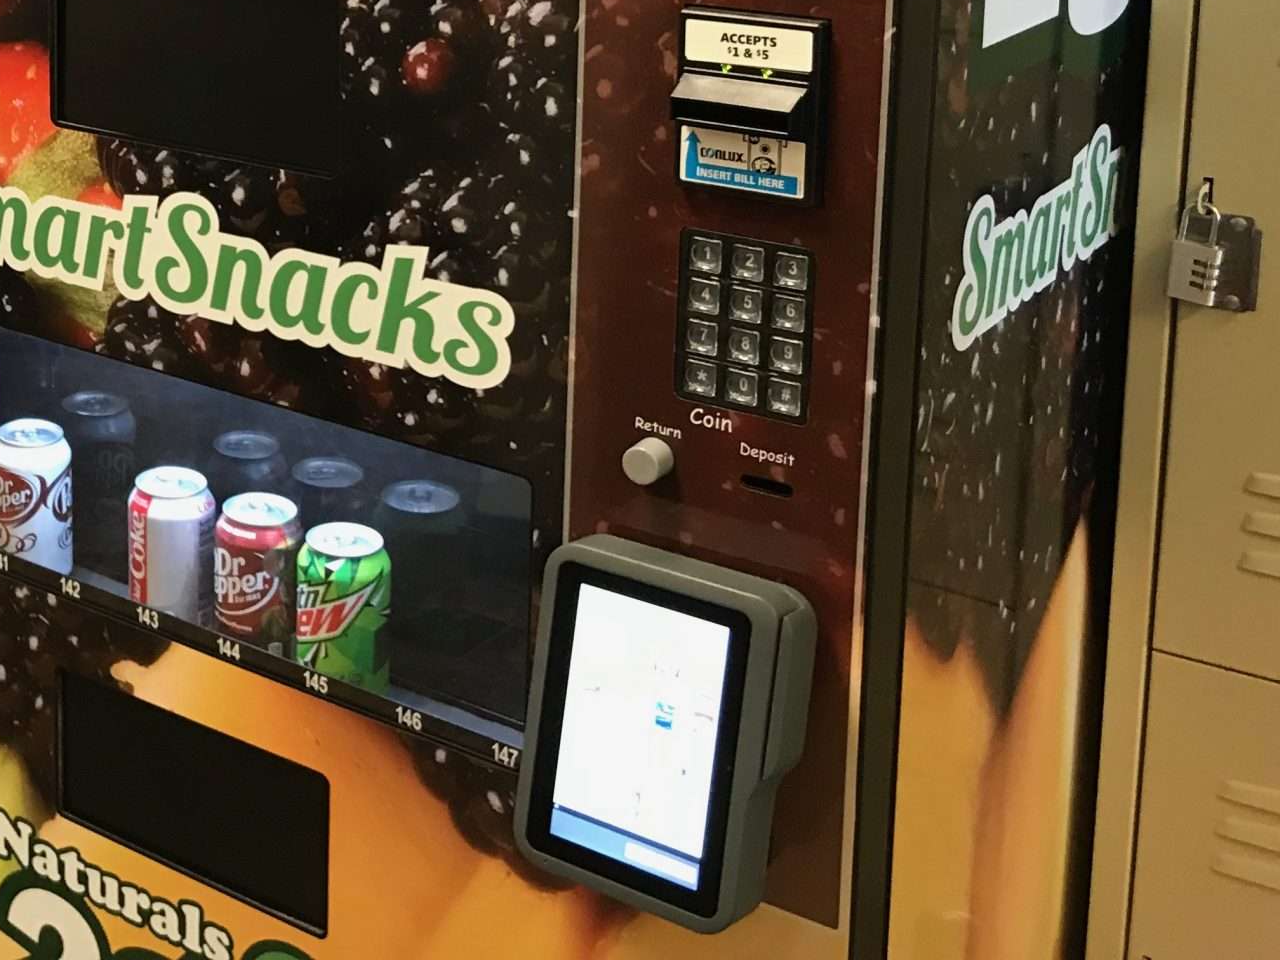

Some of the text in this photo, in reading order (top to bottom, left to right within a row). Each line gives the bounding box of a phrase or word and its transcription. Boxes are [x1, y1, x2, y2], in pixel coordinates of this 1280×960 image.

[720, 32, 777, 47] ACCEPTS
[727, 47, 769, 60] $1 & $5
[696, 165, 785, 189] INSERT BILL HERE
[957, 134, 1120, 338] SmartSn
[704, 246, 711, 260] 1
[745, 253, 755, 267] 2
[788, 261, 798, 275] 3
[700, 287, 711, 301] 4
[743, 296, 753, 309] 5
[786, 304, 796, 318] 6
[699, 328, 709, 341] 7
[740, 336, 750, 351] 8
[783, 345, 793, 359] 9
[635, 416, 682, 440] Return
[690, 408, 733, 433] Coin
[739, 442, 796, 467] Deposit
[214, 547, 246, 576] Dr
[60, 576, 81, 599] 142
[136, 606, 159, 629] 143
[217, 638, 241, 661] 144
[303, 670, 329, 694] 145
[395, 705, 422, 730] 146
[491, 742, 519, 767] 147
